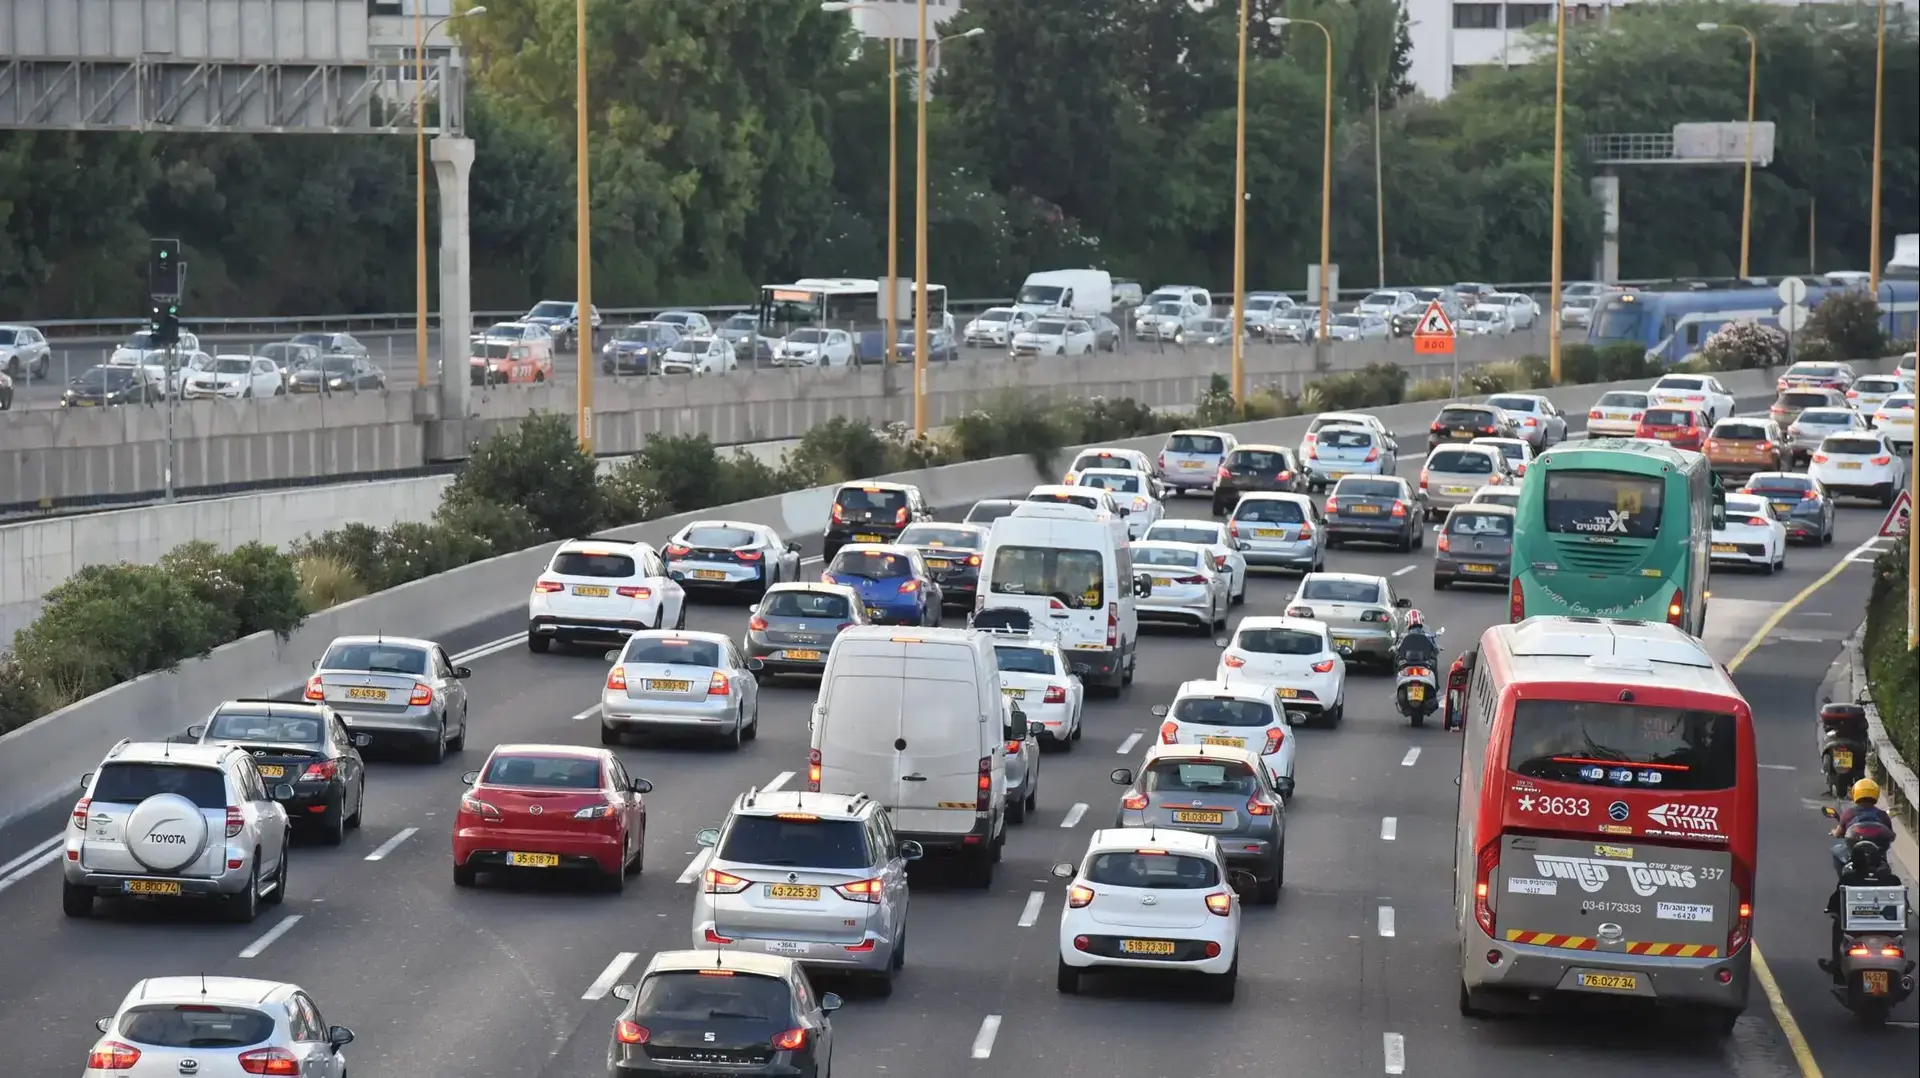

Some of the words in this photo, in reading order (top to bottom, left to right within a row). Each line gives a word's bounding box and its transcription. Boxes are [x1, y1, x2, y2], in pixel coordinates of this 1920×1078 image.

[1667, 804, 1718, 819] הנתיב
[1667, 815, 1719, 831] המהיר
[150, 834, 186, 844] TOYOTA
[1533, 855, 1610, 893] UNITED
[1604, 860, 1697, 897] TOURS
[1700, 867, 1724, 880] 337
[1583, 901, 1642, 914] 03-6173333
